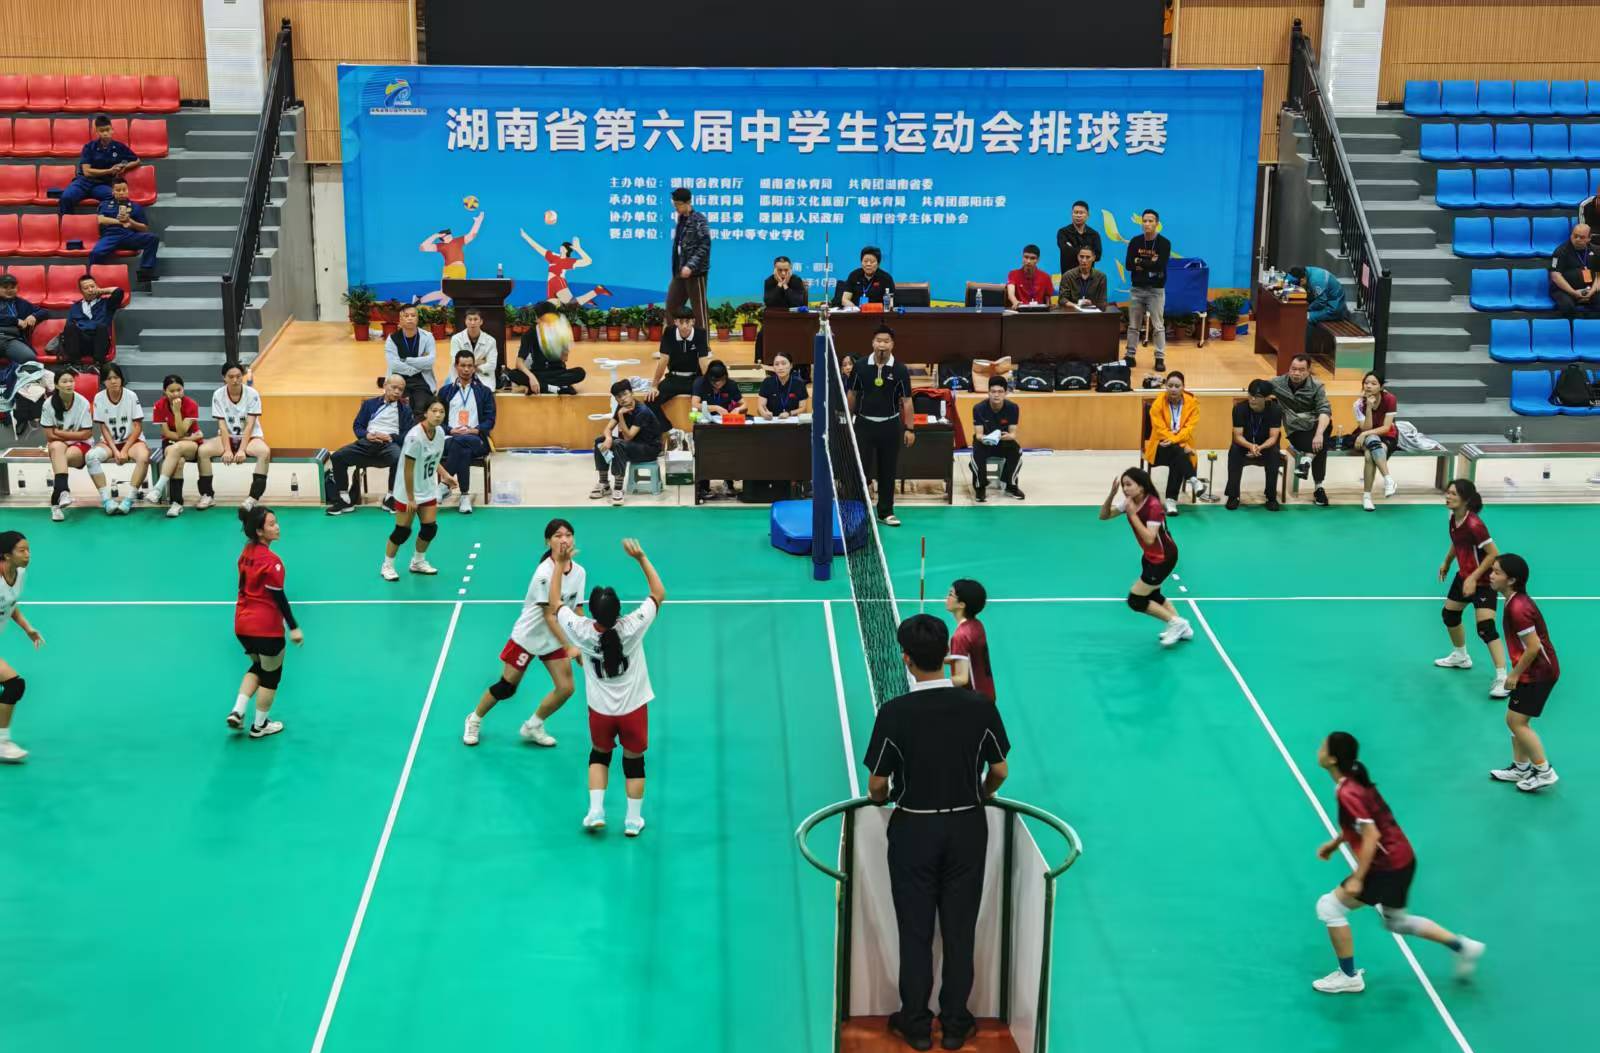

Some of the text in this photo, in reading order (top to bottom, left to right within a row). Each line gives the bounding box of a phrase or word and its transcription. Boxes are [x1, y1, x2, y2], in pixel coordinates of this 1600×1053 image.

[446, 107, 1169, 154] 湖南省第六届中学生运动会排球赛
[670, 177, 744, 189] 湖南省教育厅
[759, 178, 833, 190] 湖南省体育局
[848, 178, 933, 191] 共青团湖南省委
[112, 426, 127, 441] 12
[423, 461, 436, 480] 16
[515, 652, 530, 667] 9
